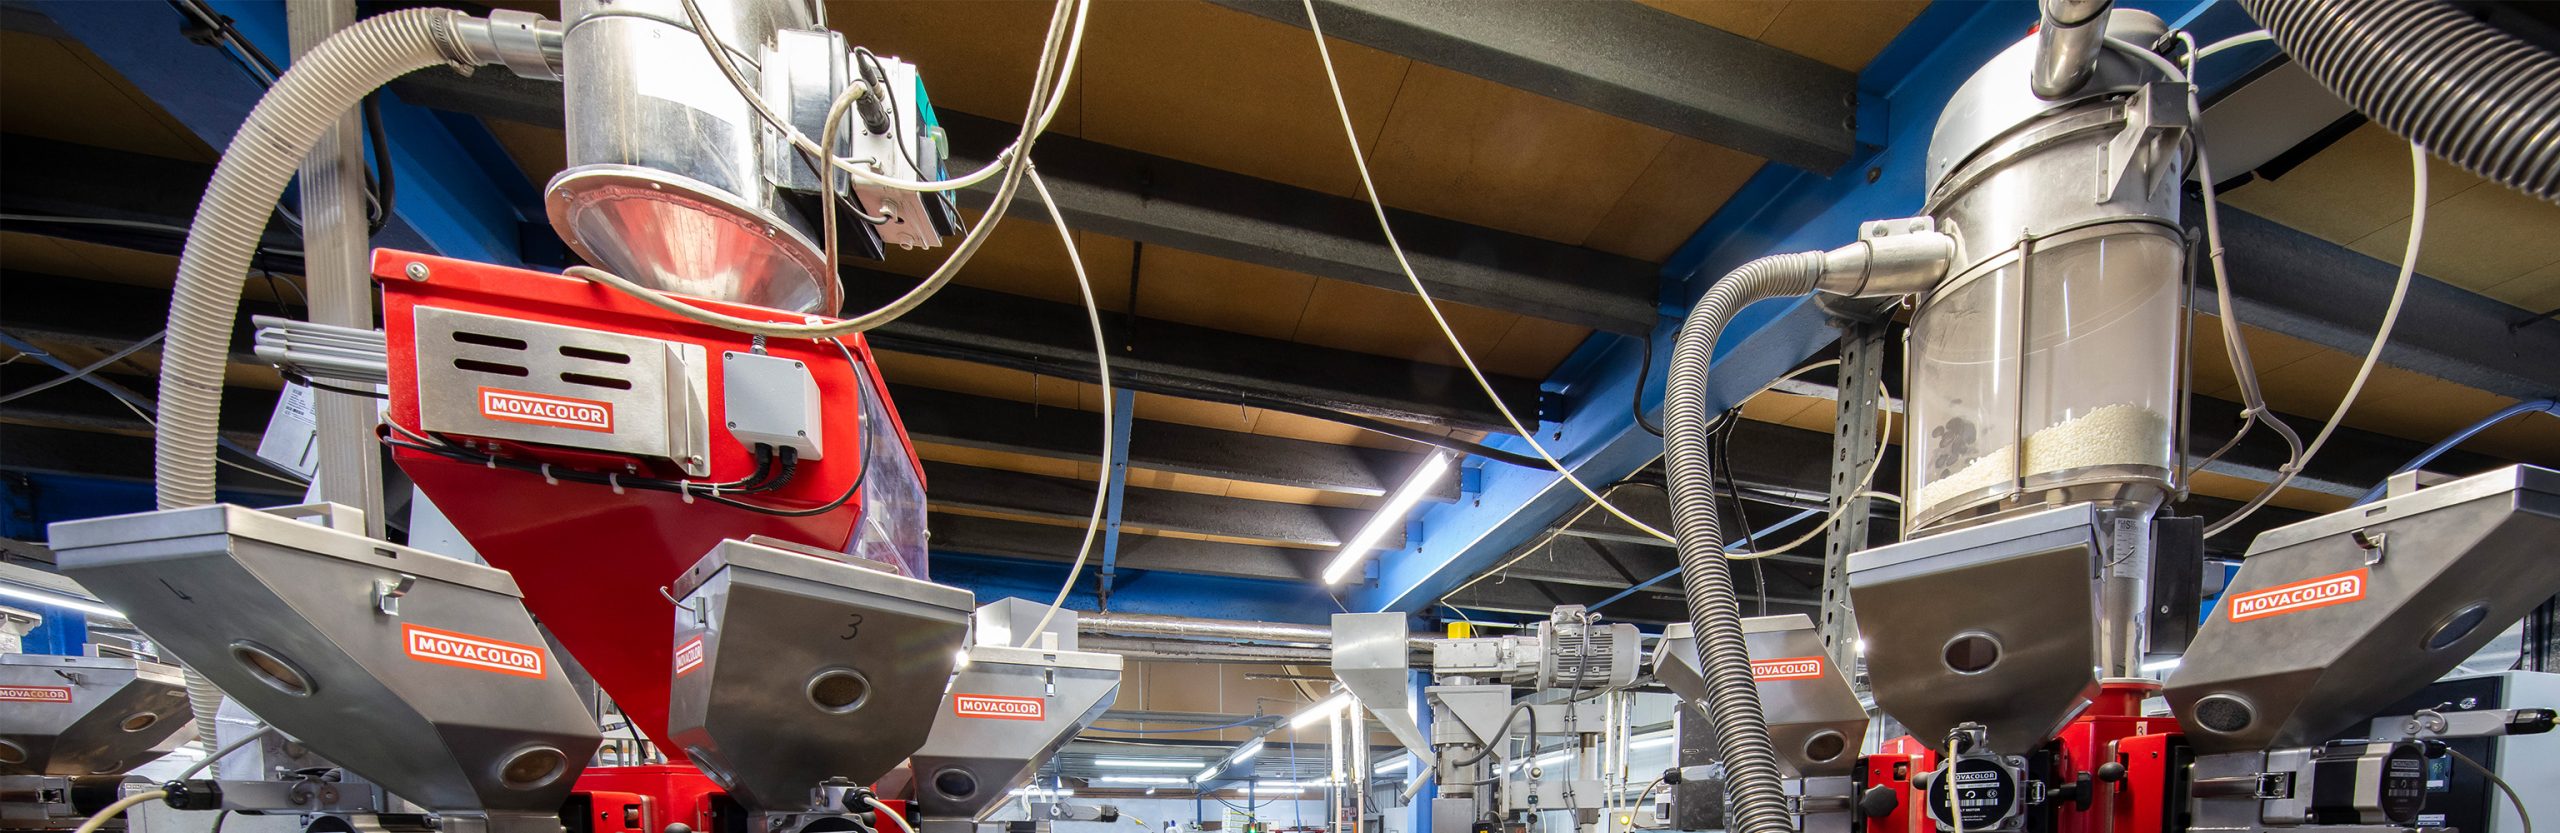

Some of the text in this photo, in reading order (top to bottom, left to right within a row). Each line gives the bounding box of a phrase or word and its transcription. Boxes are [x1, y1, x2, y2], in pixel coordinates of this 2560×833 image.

[492, 397, 602, 422] MOVACOLOR
[2240, 580, 2352, 613] MOVACOLOR
[840, 613, 864, 640] 3
[418, 636, 535, 668] MOVACOLOR
[0, 689, 65, 698] MOVACOLOR
[963, 701, 1037, 714] MOVACOLOR
[1955, 772, 1995, 780] OVACOLOR
